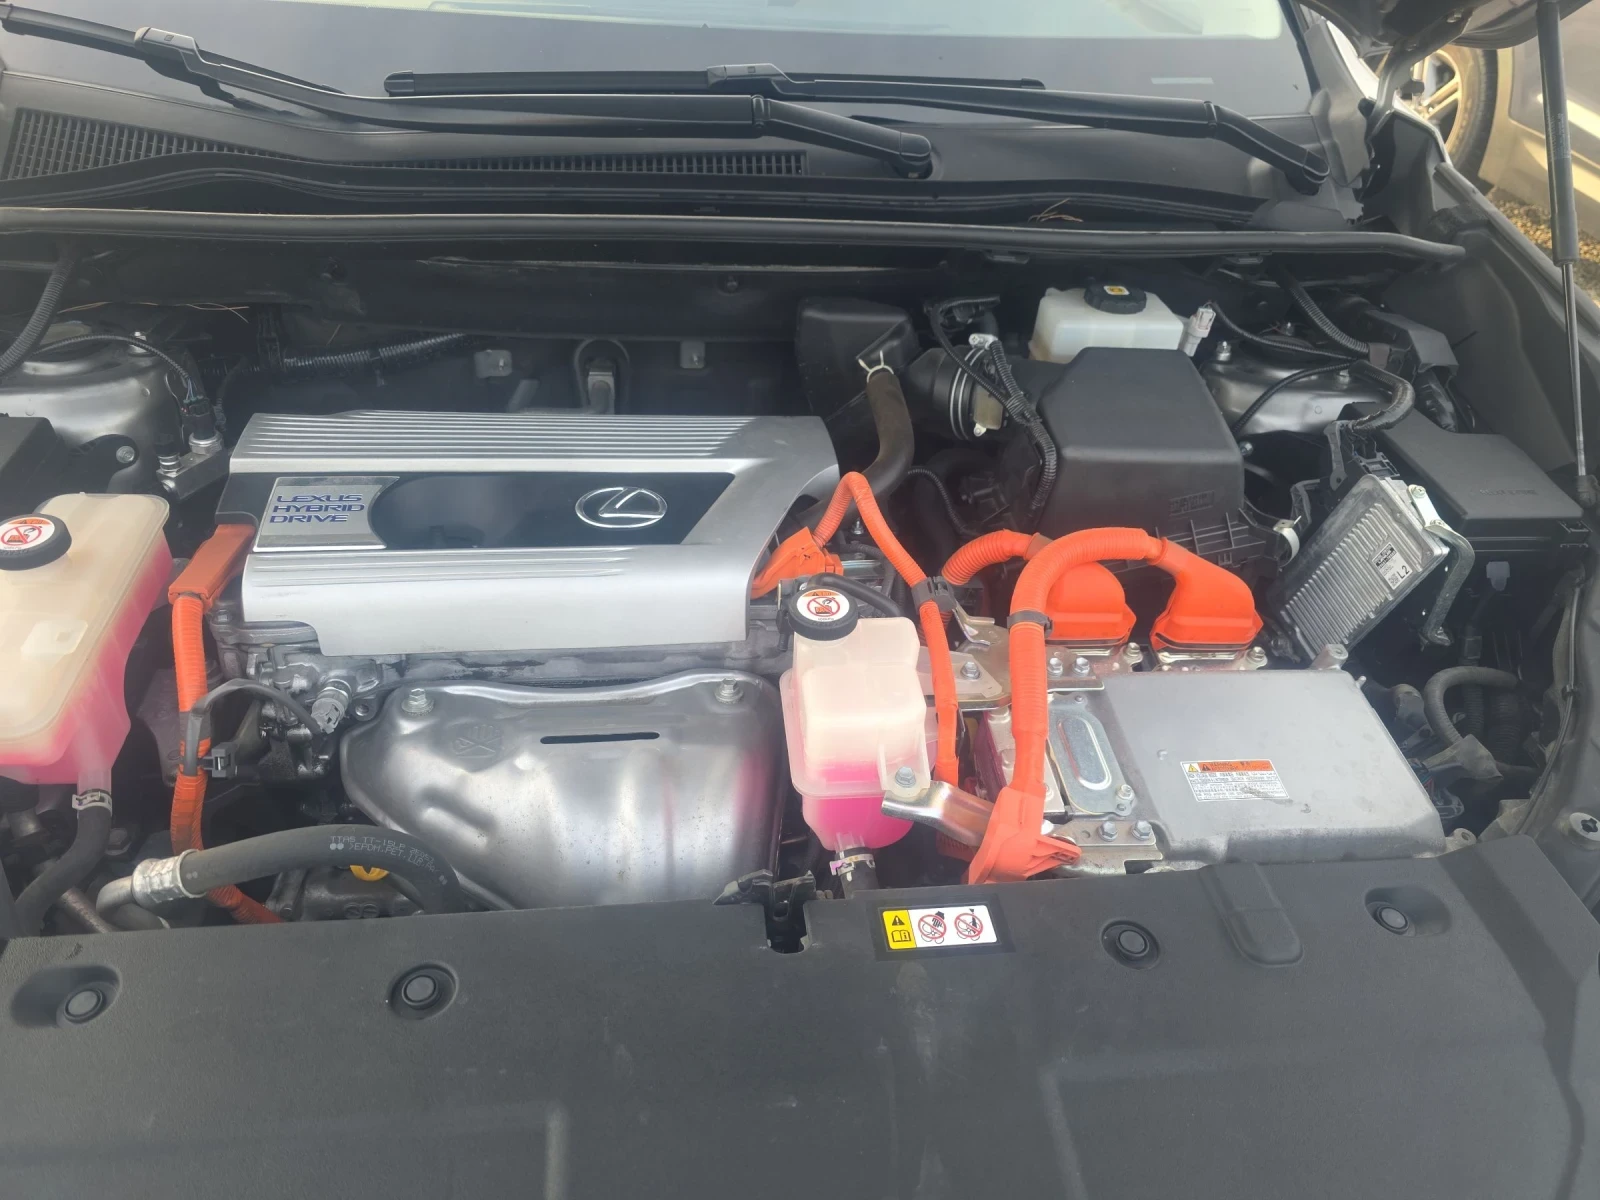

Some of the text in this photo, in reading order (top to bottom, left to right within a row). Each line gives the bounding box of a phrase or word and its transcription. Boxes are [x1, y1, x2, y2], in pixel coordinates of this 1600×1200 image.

[277, 494, 362, 503] LEXUS
[273, 504, 365, 513] HYBRID
[269, 514, 348, 523] DRIVE
